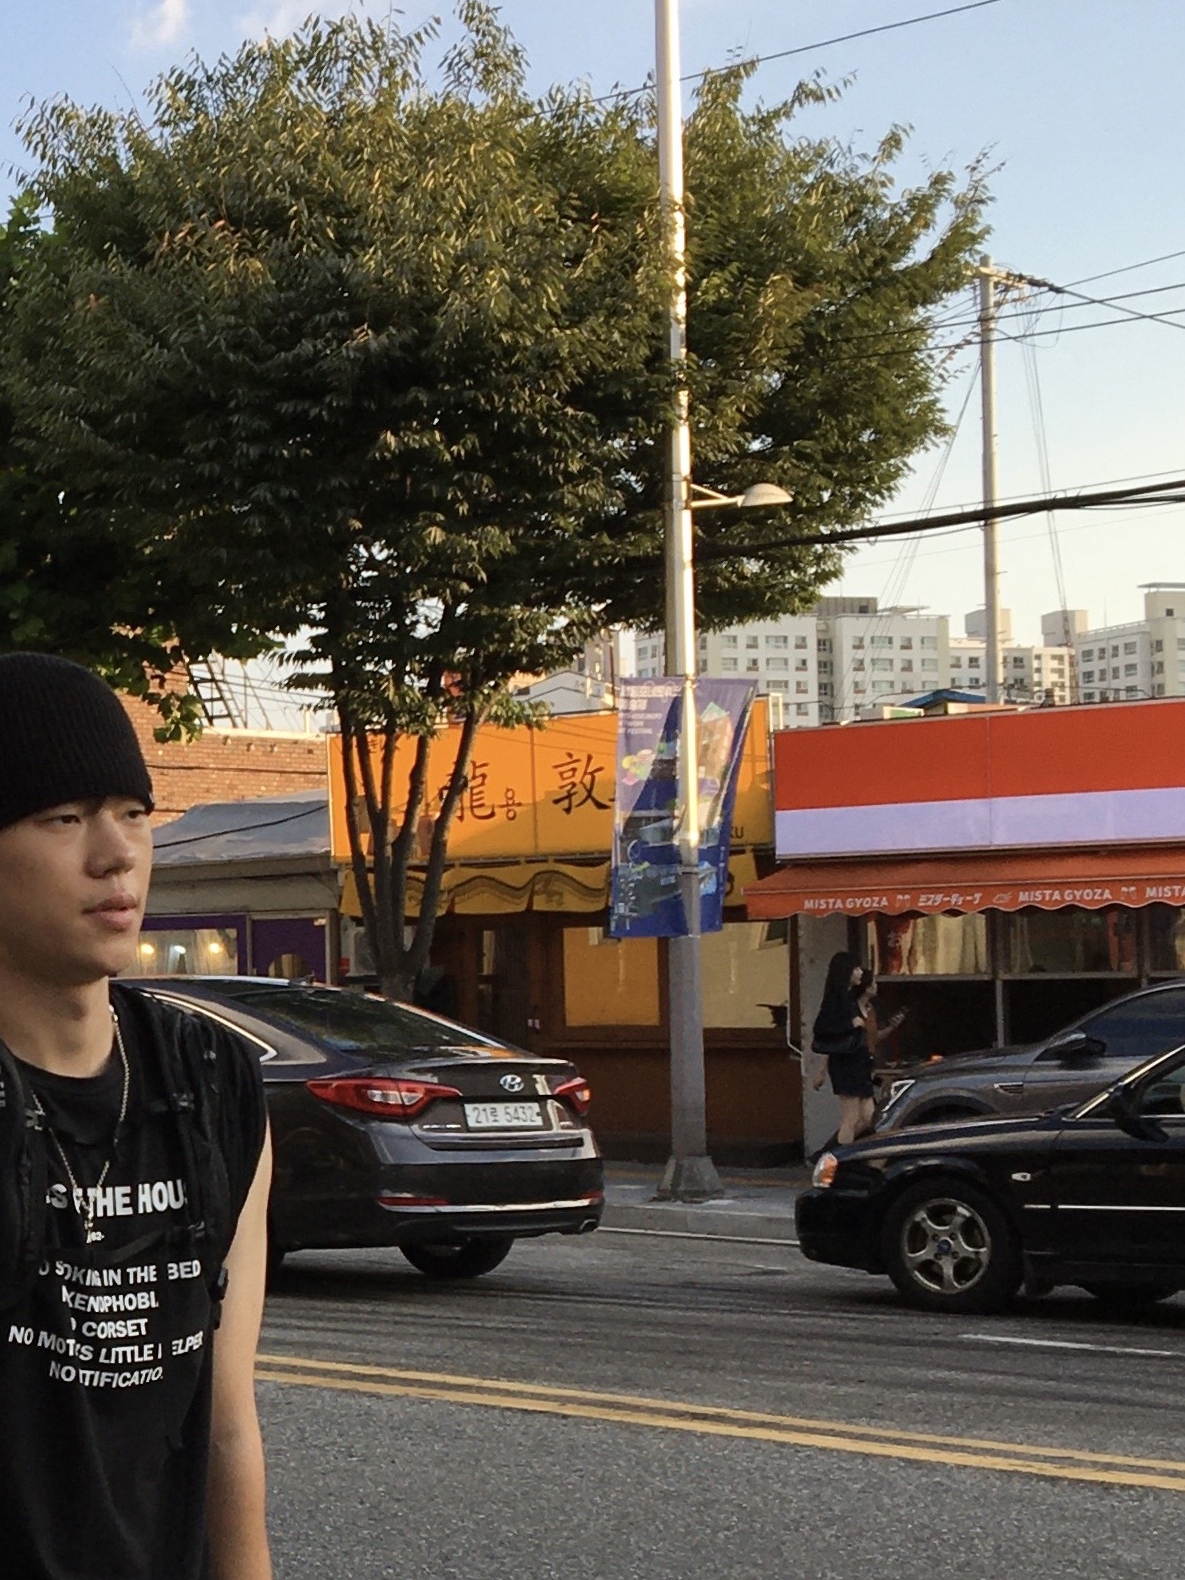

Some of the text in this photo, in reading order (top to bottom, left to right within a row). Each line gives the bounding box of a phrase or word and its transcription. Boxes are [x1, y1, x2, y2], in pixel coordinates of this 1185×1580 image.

[552, 752, 611, 815] 敦
[498, 787, 523, 821] 용
[804, 896, 889, 910] MISTA GYOZA
[1018, 888, 1112, 903] MISTA GYOZA
[87, 1186, 133, 1218] THE
[137, 1179, 188, 1214] HOU
[126, 1265, 157, 1285] THE
[82, 1317, 148, 1340] CORSET
[8, 1325, 34, 1345] NO
[99, 1343, 155, 1365] LITTLE
